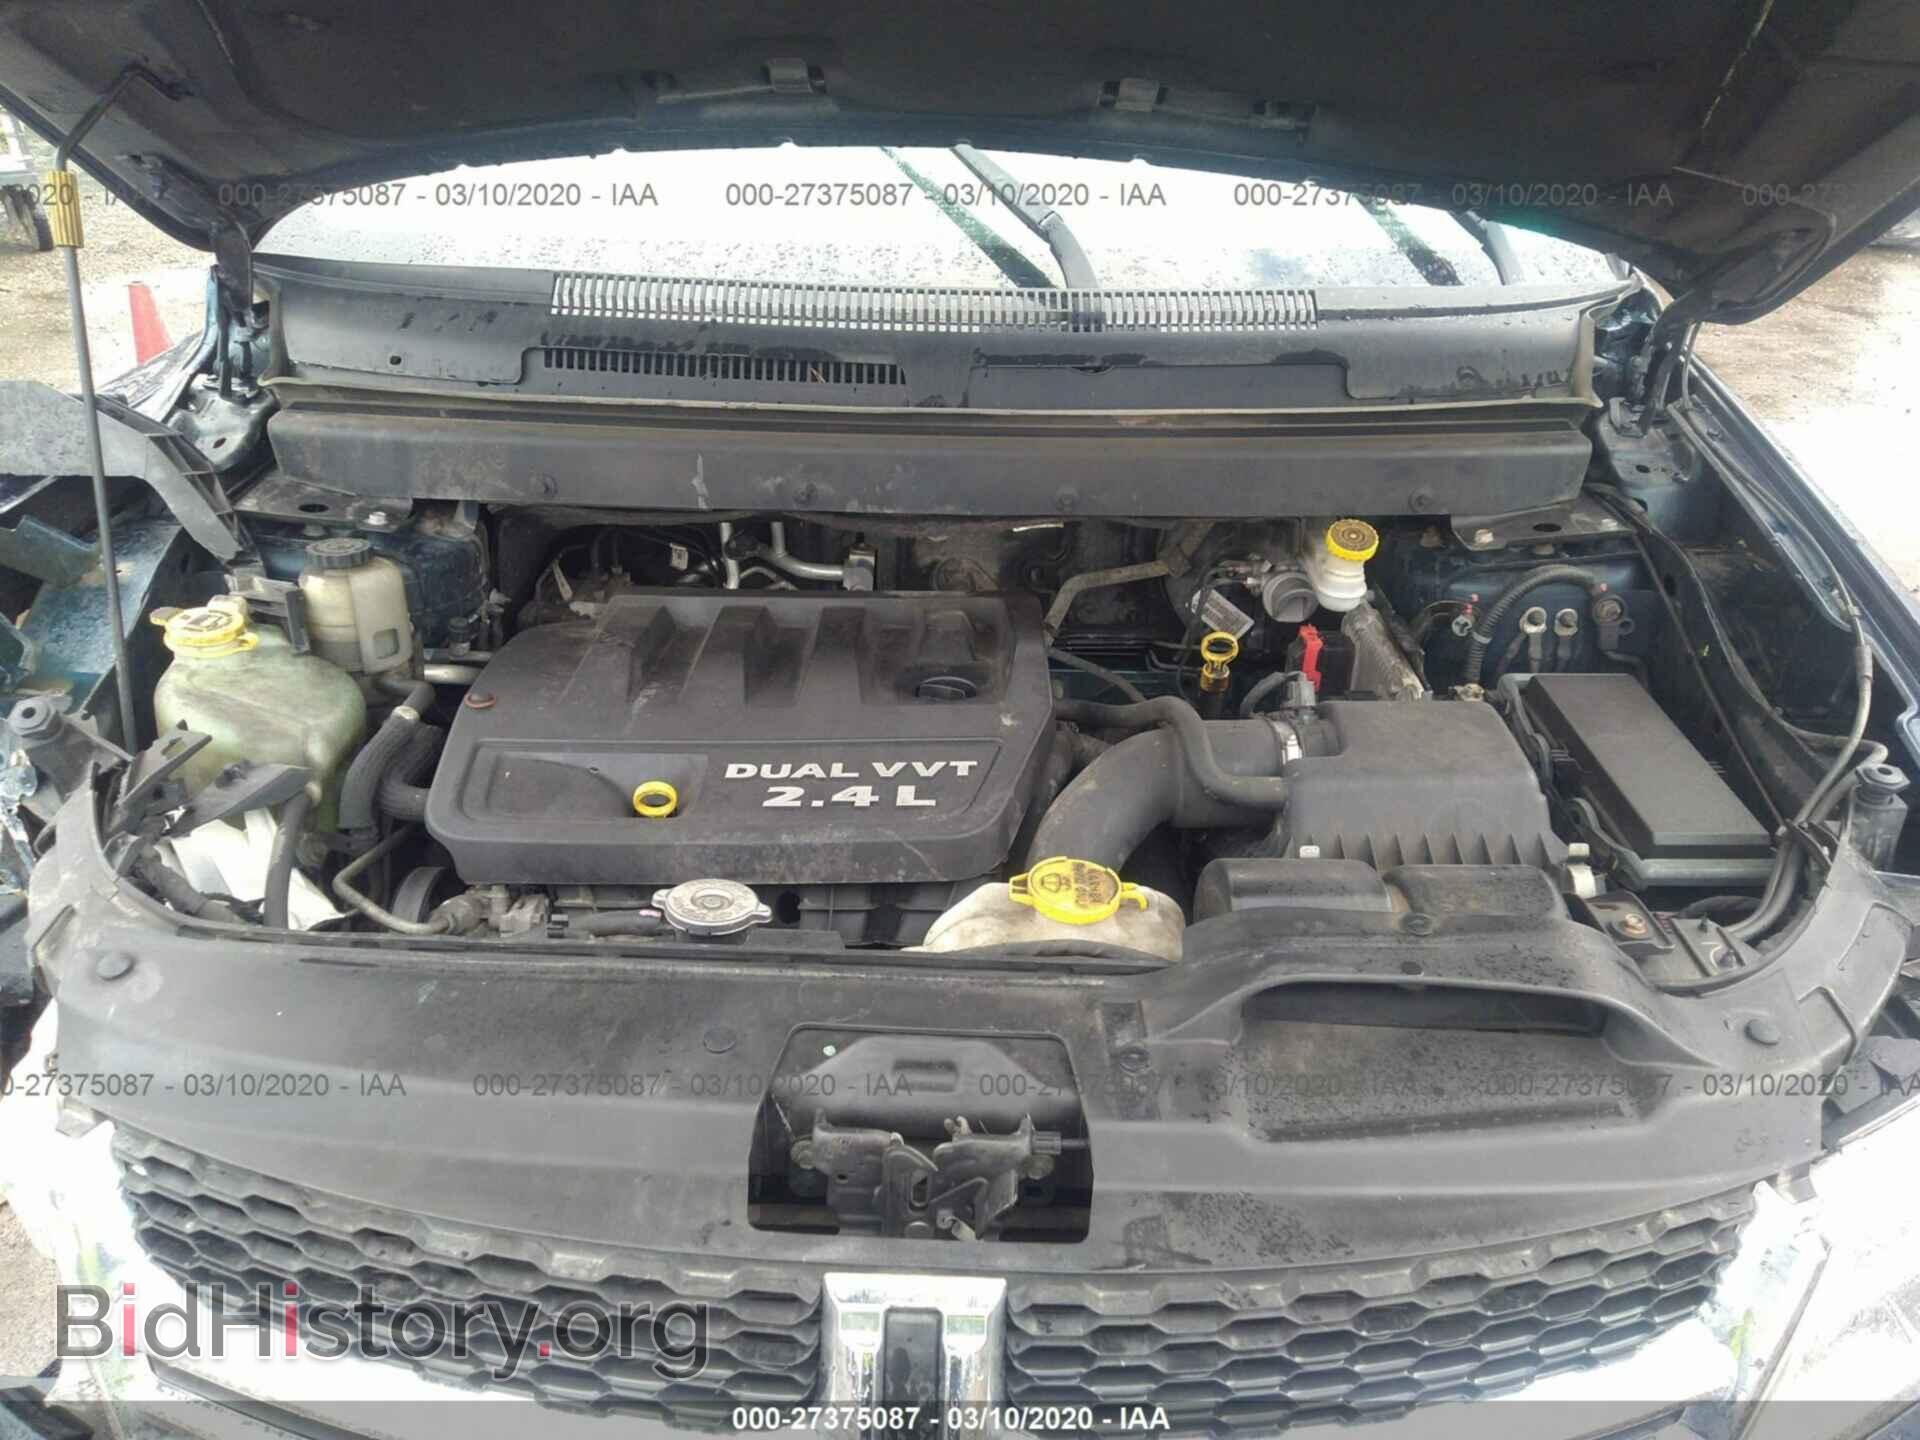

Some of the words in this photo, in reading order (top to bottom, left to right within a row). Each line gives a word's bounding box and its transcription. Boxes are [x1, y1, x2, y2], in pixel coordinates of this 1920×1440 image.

[724, 763, 860, 779] DUAL
[871, 761, 979, 777] VVT
[762, 785, 879, 807] 2.4
[895, 785, 937, 806] L
